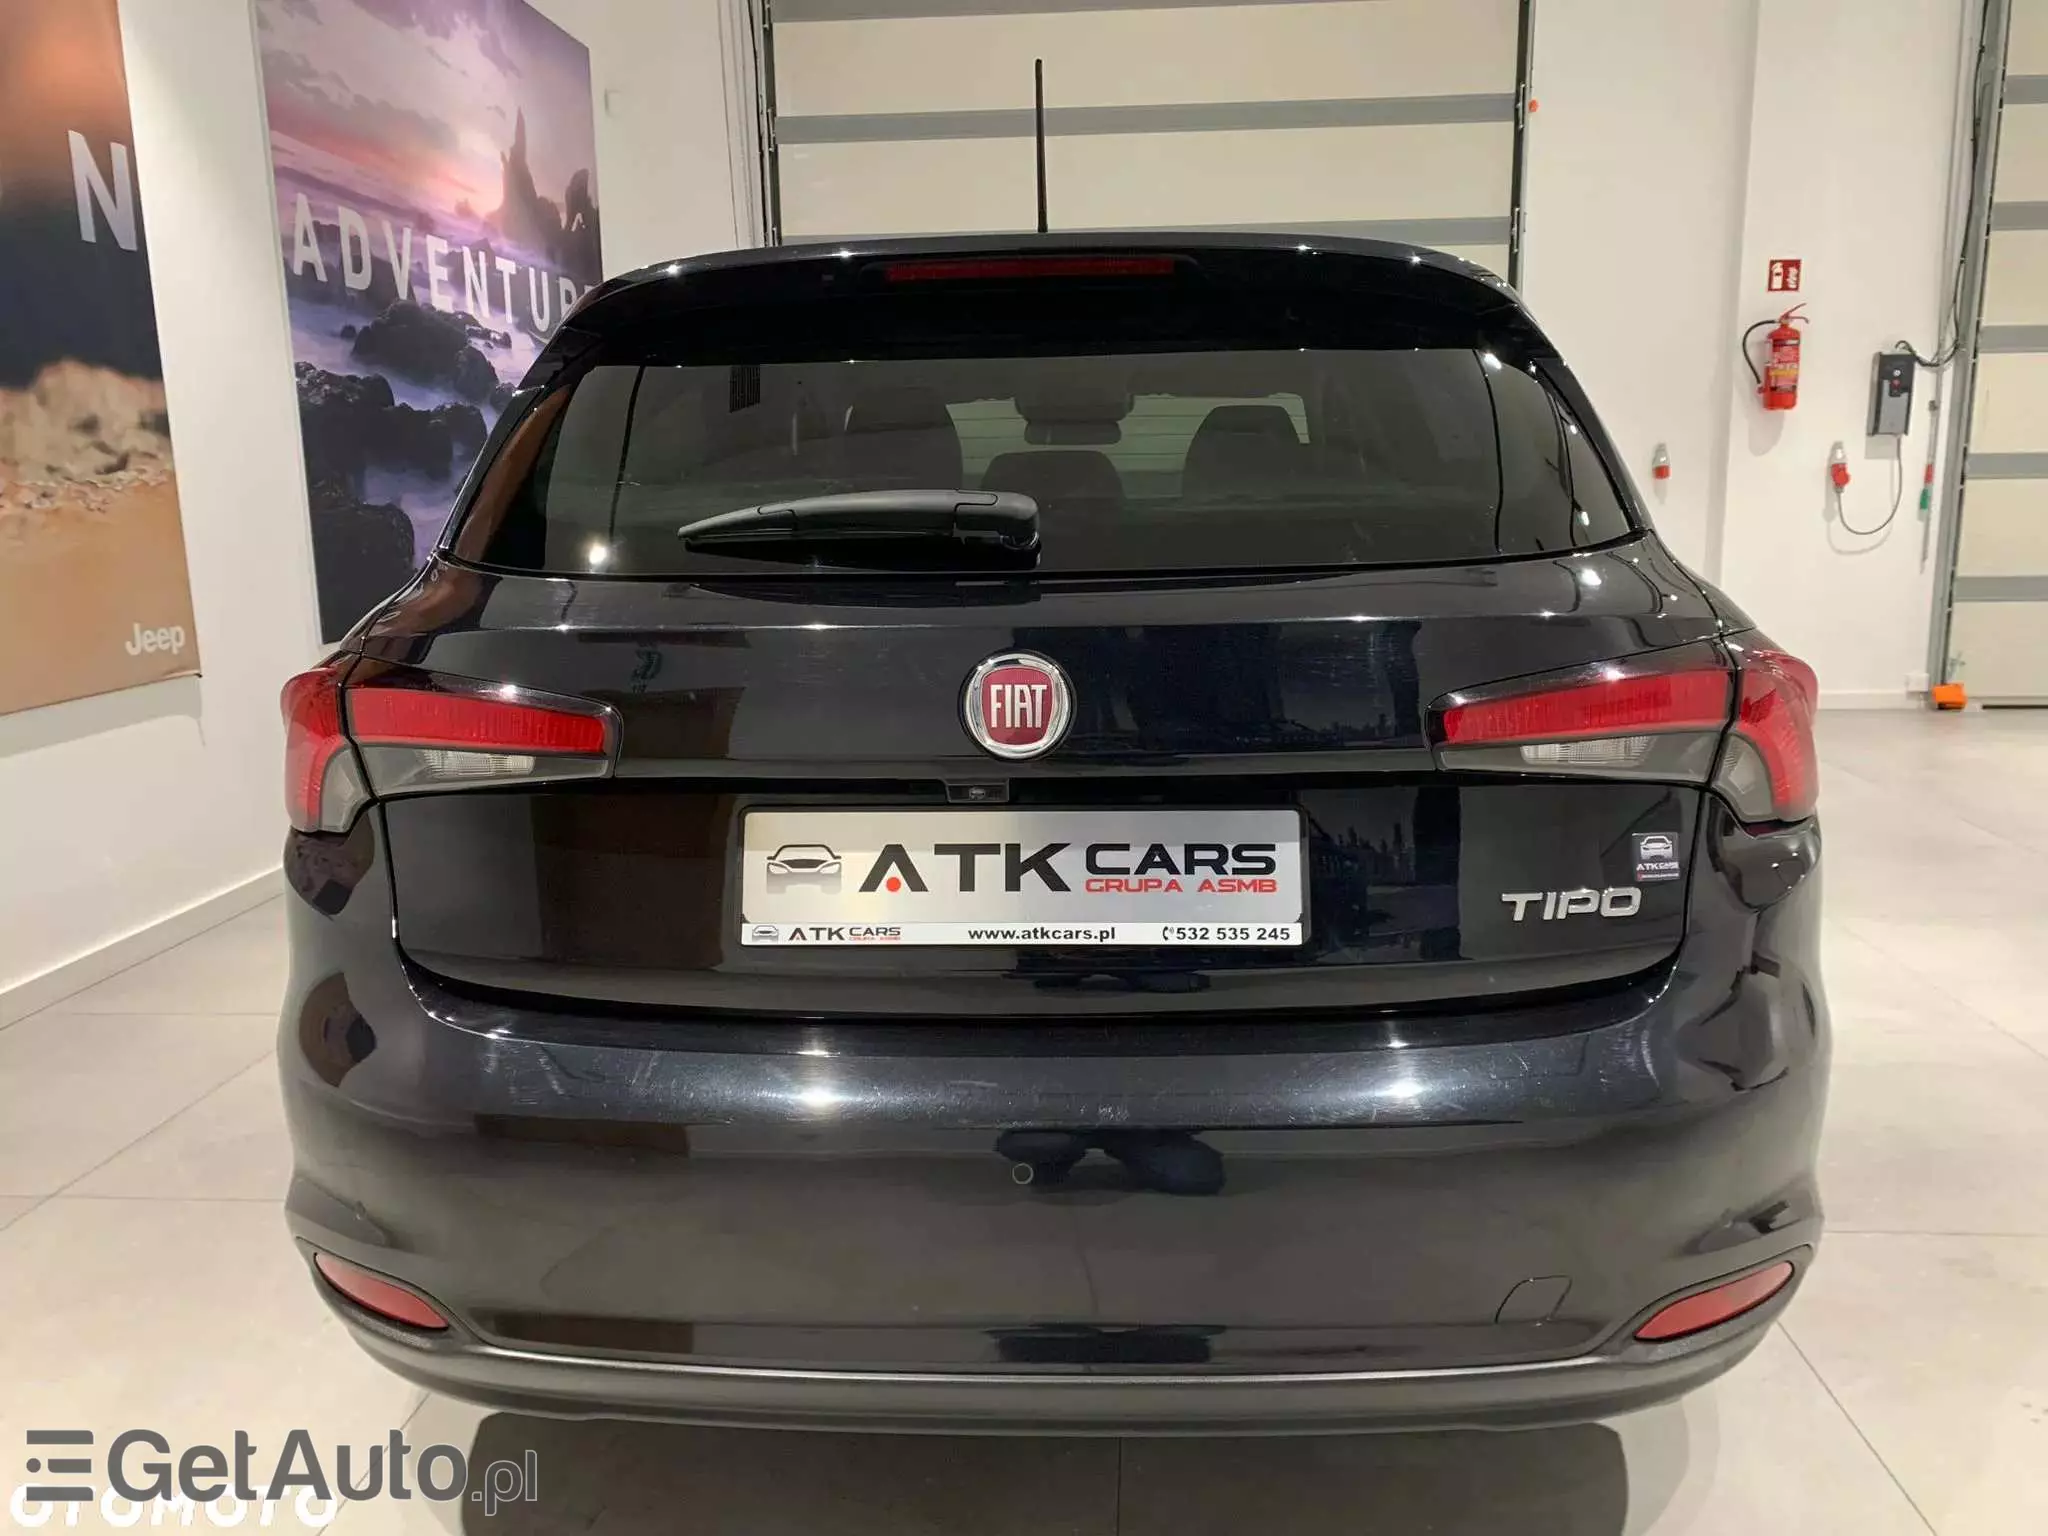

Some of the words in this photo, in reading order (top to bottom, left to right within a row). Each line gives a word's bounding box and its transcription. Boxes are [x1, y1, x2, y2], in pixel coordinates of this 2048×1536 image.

[68, 130, 138, 251] N
[293, 193, 595, 332] ADVENTUR
[125, 622, 185, 656] Jeep
[990, 684, 1047, 728] FIAT
[858, 843, 1072, 892] ATK
[1085, 843, 1276, 875] CARS
[1085, 879, 1183, 893] GRUPA
[1198, 879, 1277, 893] ASMB
[1501, 887, 1642, 922] TIPO
[788, 927, 845, 941] ATK
[849, 927, 901, 936] CARS
[968, 927, 1116, 941] www.atkcars.pl
[1176, 927, 1209, 940] 532
[1217, 927, 1250, 940] 535
[1257, 927, 1290, 940] 245
